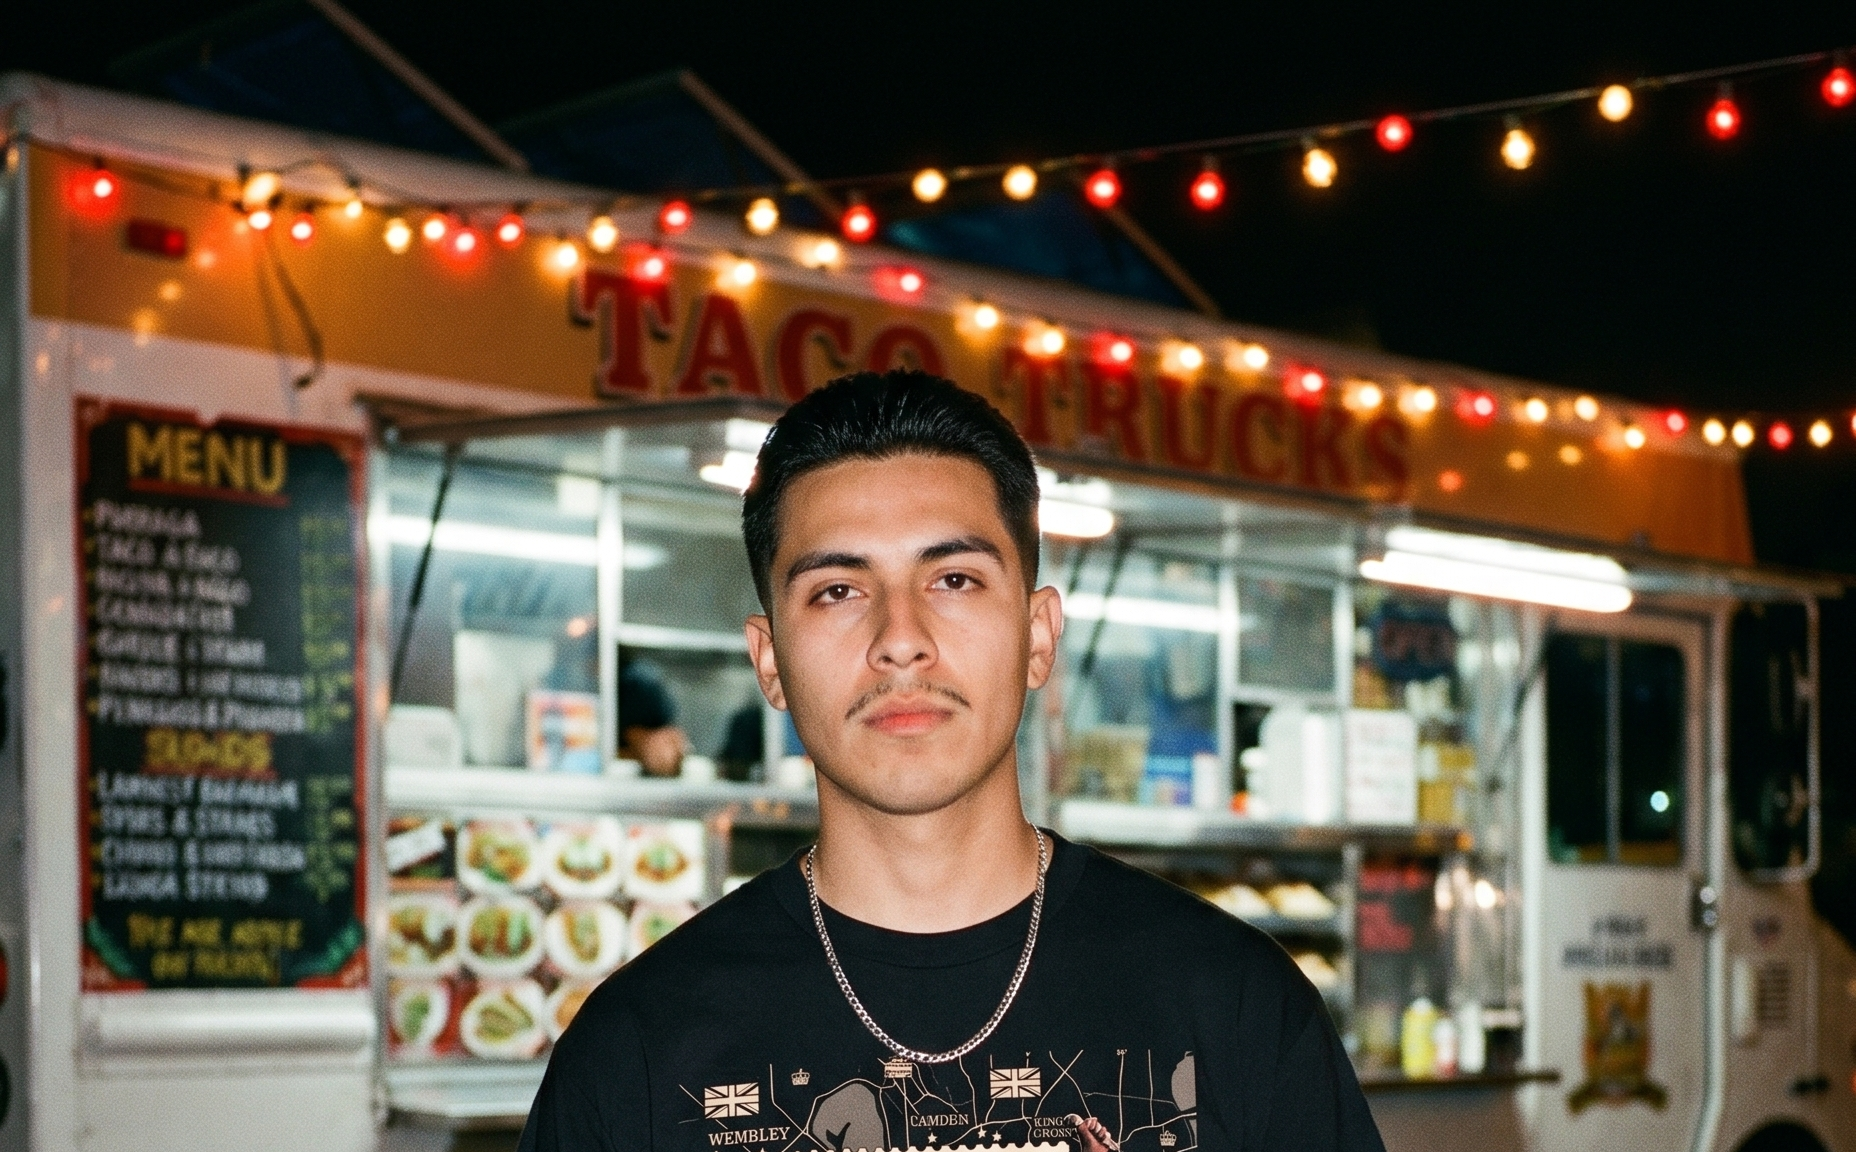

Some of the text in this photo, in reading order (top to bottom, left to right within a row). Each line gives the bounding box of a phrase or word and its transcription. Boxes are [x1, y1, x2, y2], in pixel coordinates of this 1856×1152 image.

[1000, 345, 1410, 492] TRUCKS
[126, 423, 288, 495] MENU
[708, 1126, 791, 1146] WEMBLEY
